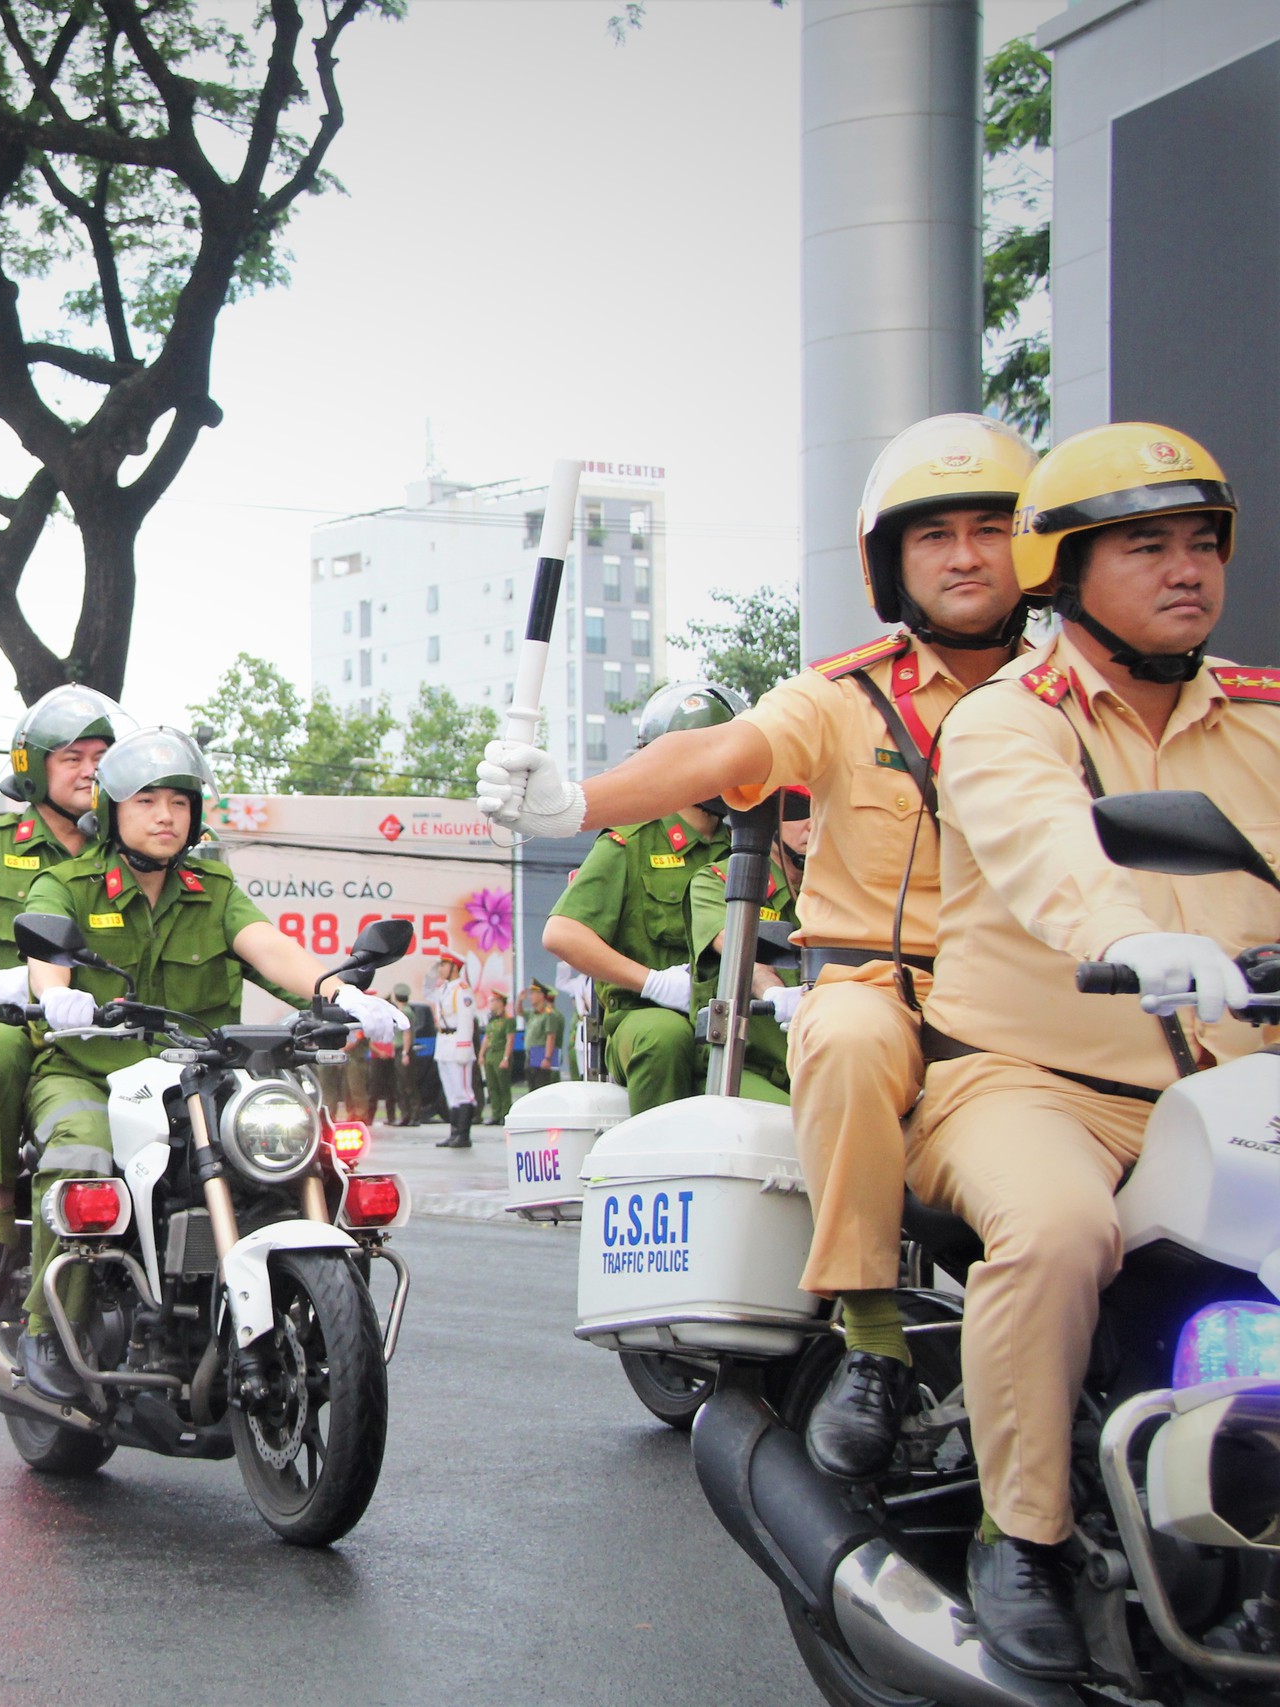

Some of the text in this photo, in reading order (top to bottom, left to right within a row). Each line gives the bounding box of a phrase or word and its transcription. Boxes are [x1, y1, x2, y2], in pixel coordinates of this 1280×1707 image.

[618, 463, 665, 478] CENTER
[23, 858, 37, 868] 113
[653, 855, 665, 865] CS
[342, 876, 393, 899] CÁO
[91, 915, 121, 925] CS 113
[516, 1149, 561, 1183] POLICE
[603, 1191, 693, 1247] C.S.G.T
[602, 1250, 689, 1274] TRAFFIC POLICE
